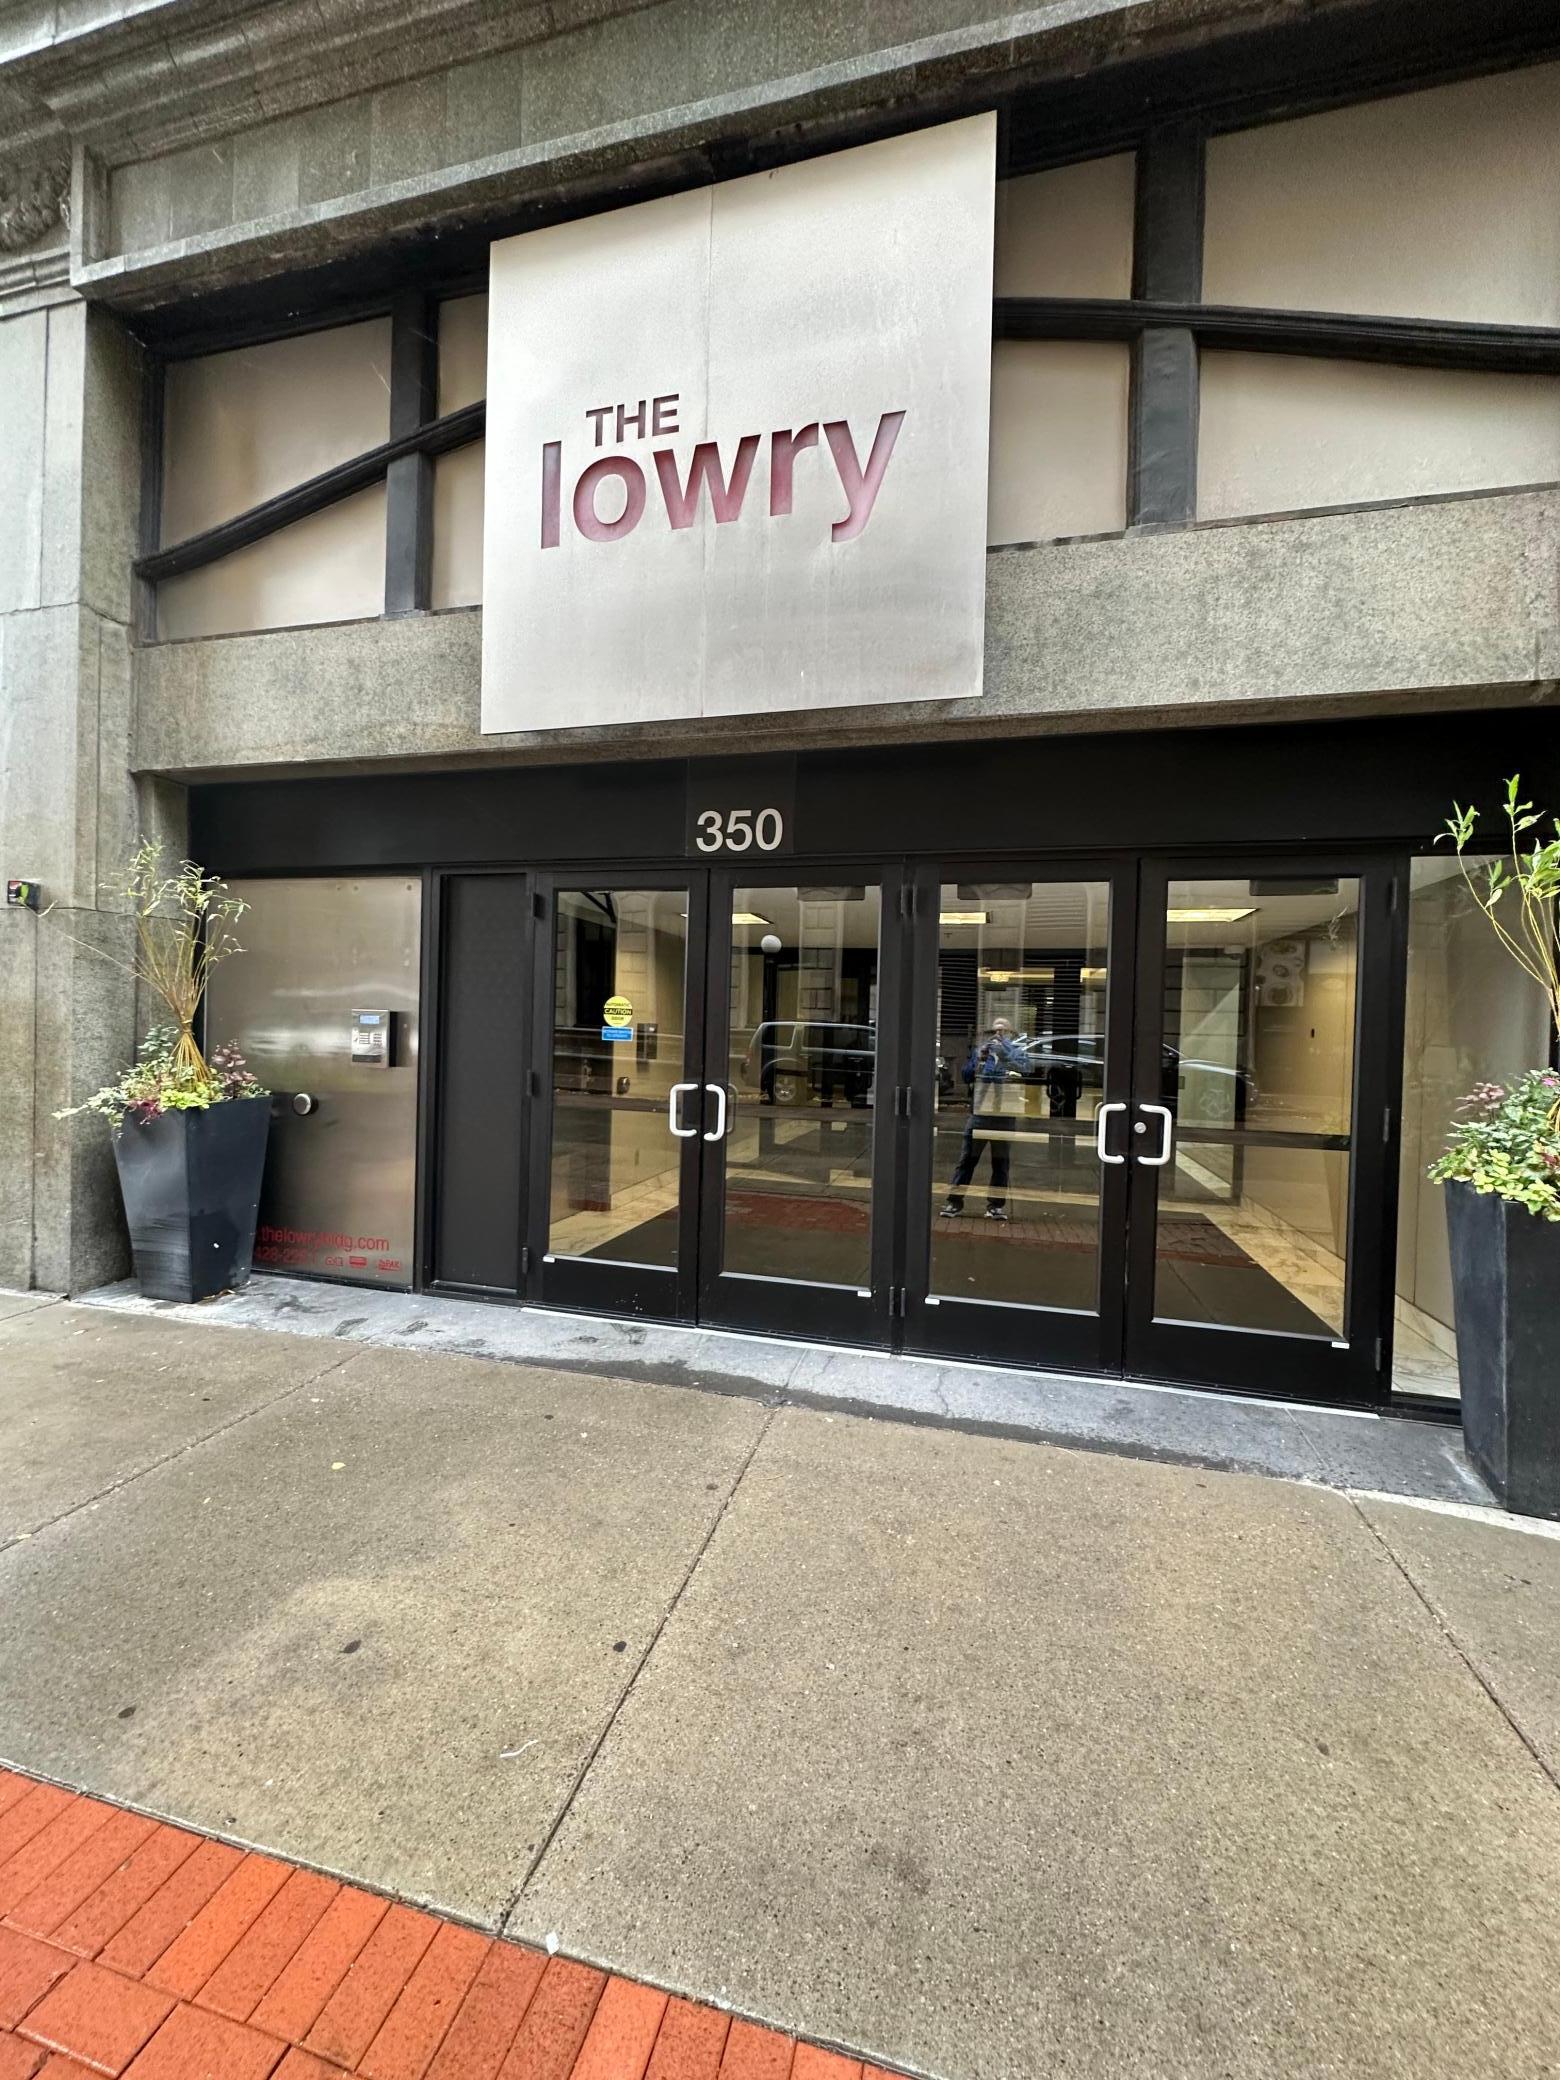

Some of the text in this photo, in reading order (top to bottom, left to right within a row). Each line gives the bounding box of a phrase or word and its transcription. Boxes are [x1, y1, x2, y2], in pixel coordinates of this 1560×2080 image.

[586, 393, 680, 447] THE
[541, 410, 906, 550] lowry
[696, 808, 783, 852] 350
